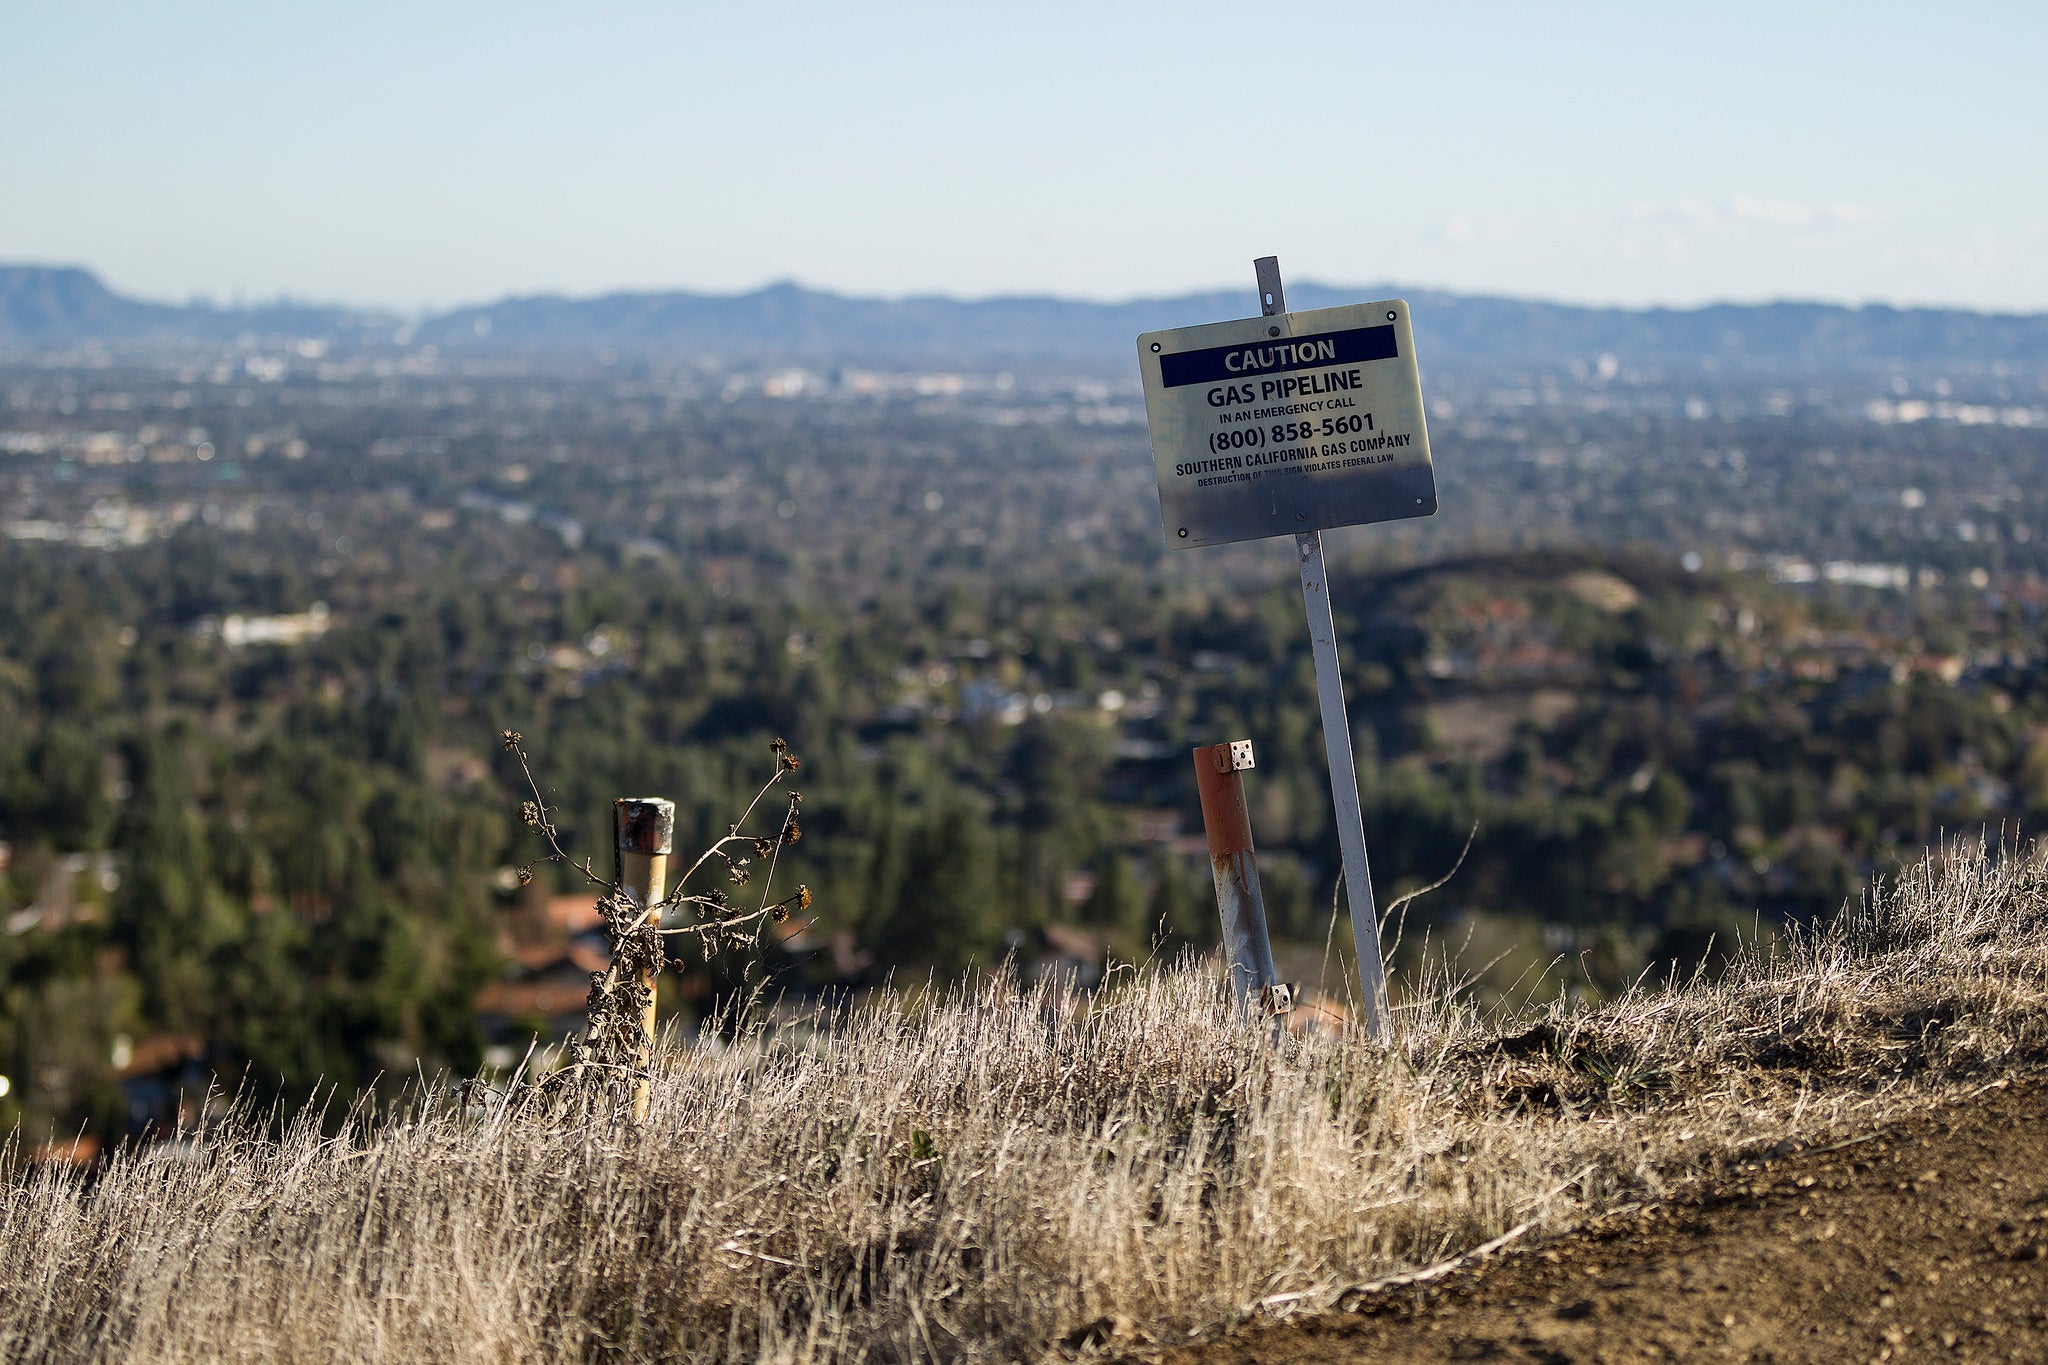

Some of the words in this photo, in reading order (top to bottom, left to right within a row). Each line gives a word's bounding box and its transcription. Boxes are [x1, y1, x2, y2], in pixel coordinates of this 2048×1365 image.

[1224, 339, 1336, 372] CAUTION
[1207, 383, 1256, 407] GAS
[1261, 369, 1363, 401] PIPELINE
[1219, 414, 1232, 424] IN
[1234, 411, 1251, 421] AN
[1254, 400, 1324, 419] EMERGENCY
[1326, 397, 1356, 409] CALL
[1209, 426, 1266, 454] (800)
[1271, 413, 1375, 443] 858-5601
[1175, 456, 1242, 477] SOUTHERN
[1245, 447, 1318, 467] CALIFORNIA
[1321, 442, 1347, 457] GAS
[1350, 434, 1412, 453] COMPANY
[1198, 472, 1251, 487] DESTRUCTION
[1252, 470, 1263, 480] OF
[1283, 465, 1303, 475] SIGN
[1304, 460, 1341, 473] VIOLATES
[1343, 456, 1376, 467] FEDERAL
[1377, 453, 1394, 463] LAW
